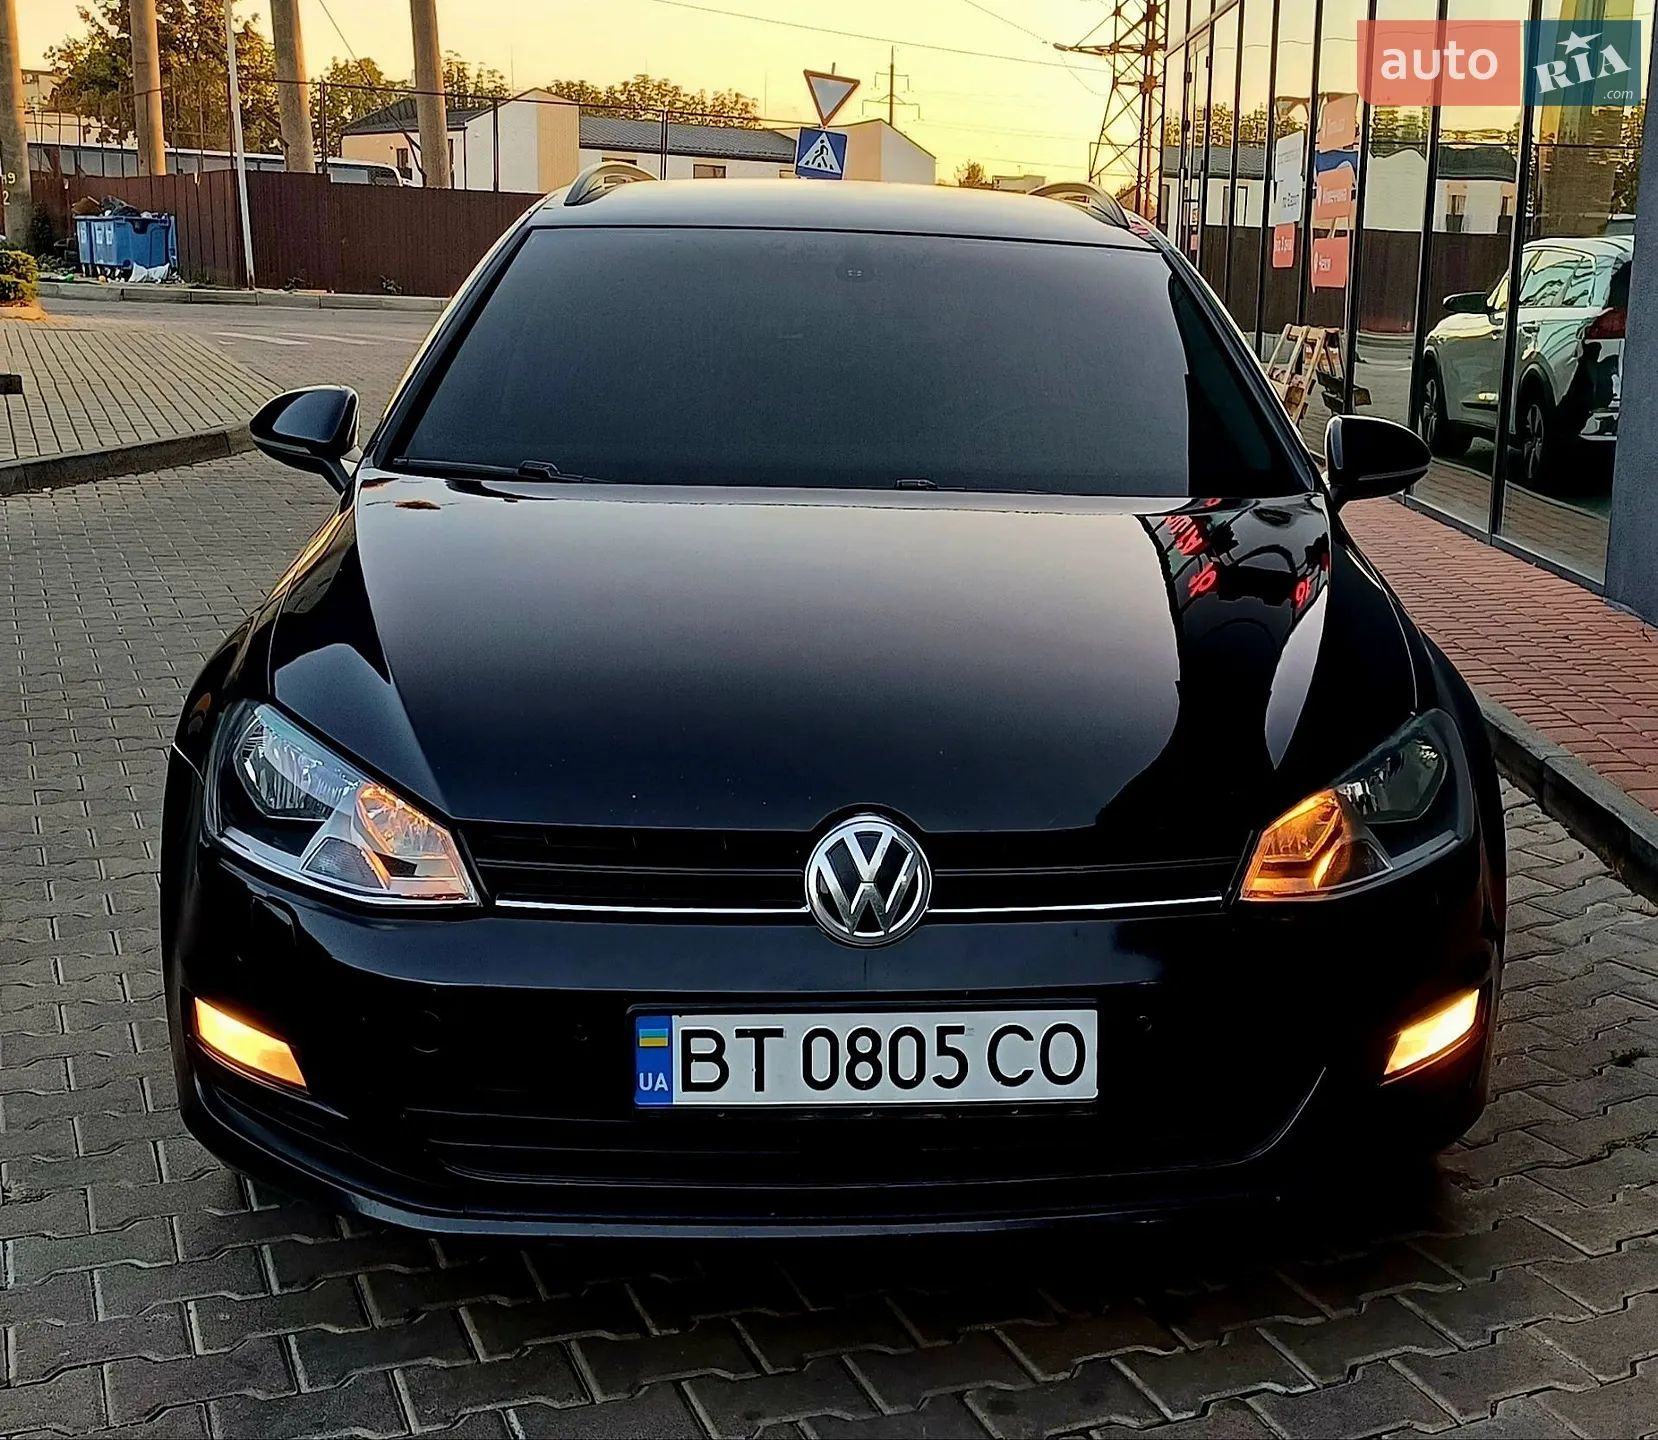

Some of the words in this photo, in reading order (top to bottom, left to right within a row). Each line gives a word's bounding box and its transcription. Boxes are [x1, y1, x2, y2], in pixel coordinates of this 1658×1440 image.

[680, 1027, 785, 1092] BT
[802, 1025, 970, 1092] 0805
[987, 1023, 1087, 1087] CO
[638, 1072, 669, 1093] UA
